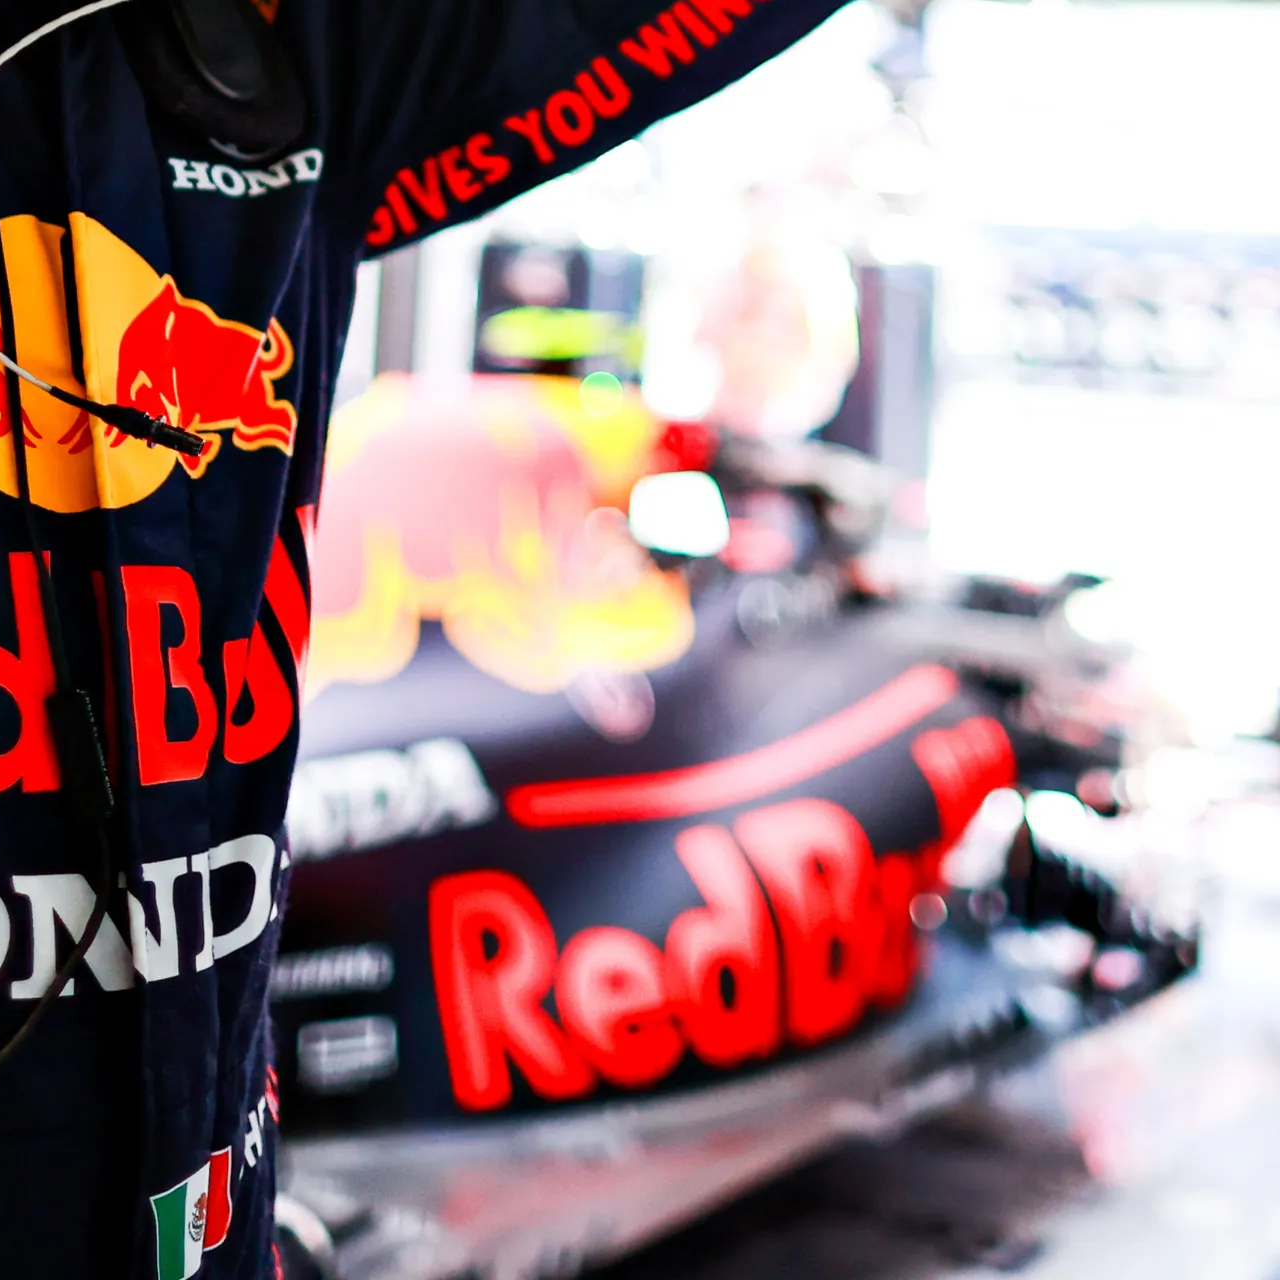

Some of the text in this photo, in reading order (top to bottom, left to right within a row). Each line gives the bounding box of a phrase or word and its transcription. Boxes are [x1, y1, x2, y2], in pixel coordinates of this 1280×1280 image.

[168, 148, 323, 197] HOND
[505, 56, 632, 166] YOU
[121, 503, 319, 786] Bul
[428, 823, 786, 1112] Red
